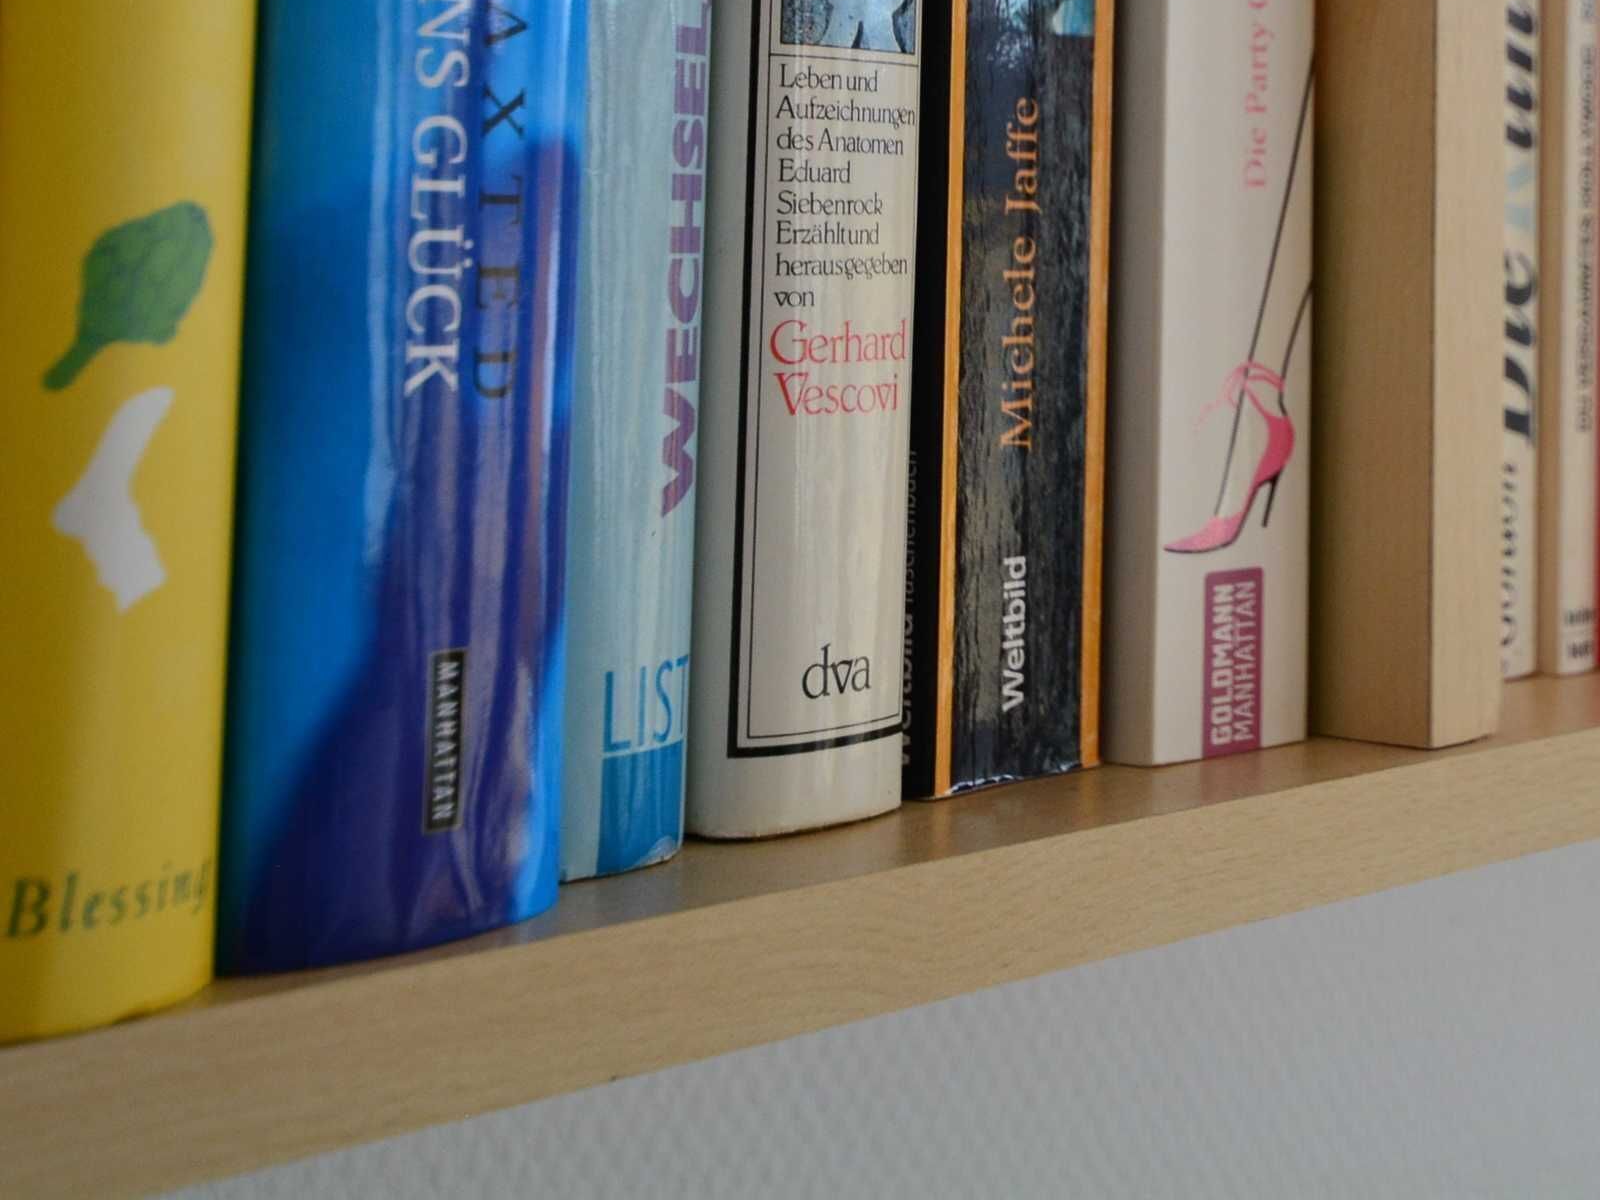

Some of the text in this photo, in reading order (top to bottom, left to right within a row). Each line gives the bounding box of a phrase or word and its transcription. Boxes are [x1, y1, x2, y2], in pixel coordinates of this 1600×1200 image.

[779, 63, 879, 93] Leben und
[1245, 22, 1276, 116] Party
[775, 94, 916, 130] Aufzeichnungen
[776, 126, 905, 156] des Anatomen
[1245, 125, 1269, 190] Die
[778, 157, 852, 184] Eduard
[775, 189, 884, 216] Siebenrock
[402, 114, 476, 398] GLÜCK
[775, 219, 881, 246] Erzählt und
[774, 252, 909, 281] herausgegeben
[1000, 95, 1042, 452] Michele Jaffe
[773, 288, 816, 308] von
[769, 317, 908, 366] Gerhard
[772, 371, 899, 417] Vescovi
[1002, 555, 1027, 713] Weltbild
[801, 642, 872, 700] dva
[1210, 583, 1236, 746] GOLDMANN
[1232, 580, 1257, 743] MANHATTAN
[604, 653, 690, 752] LIST
[431, 660, 460, 821] MANHATTAN
